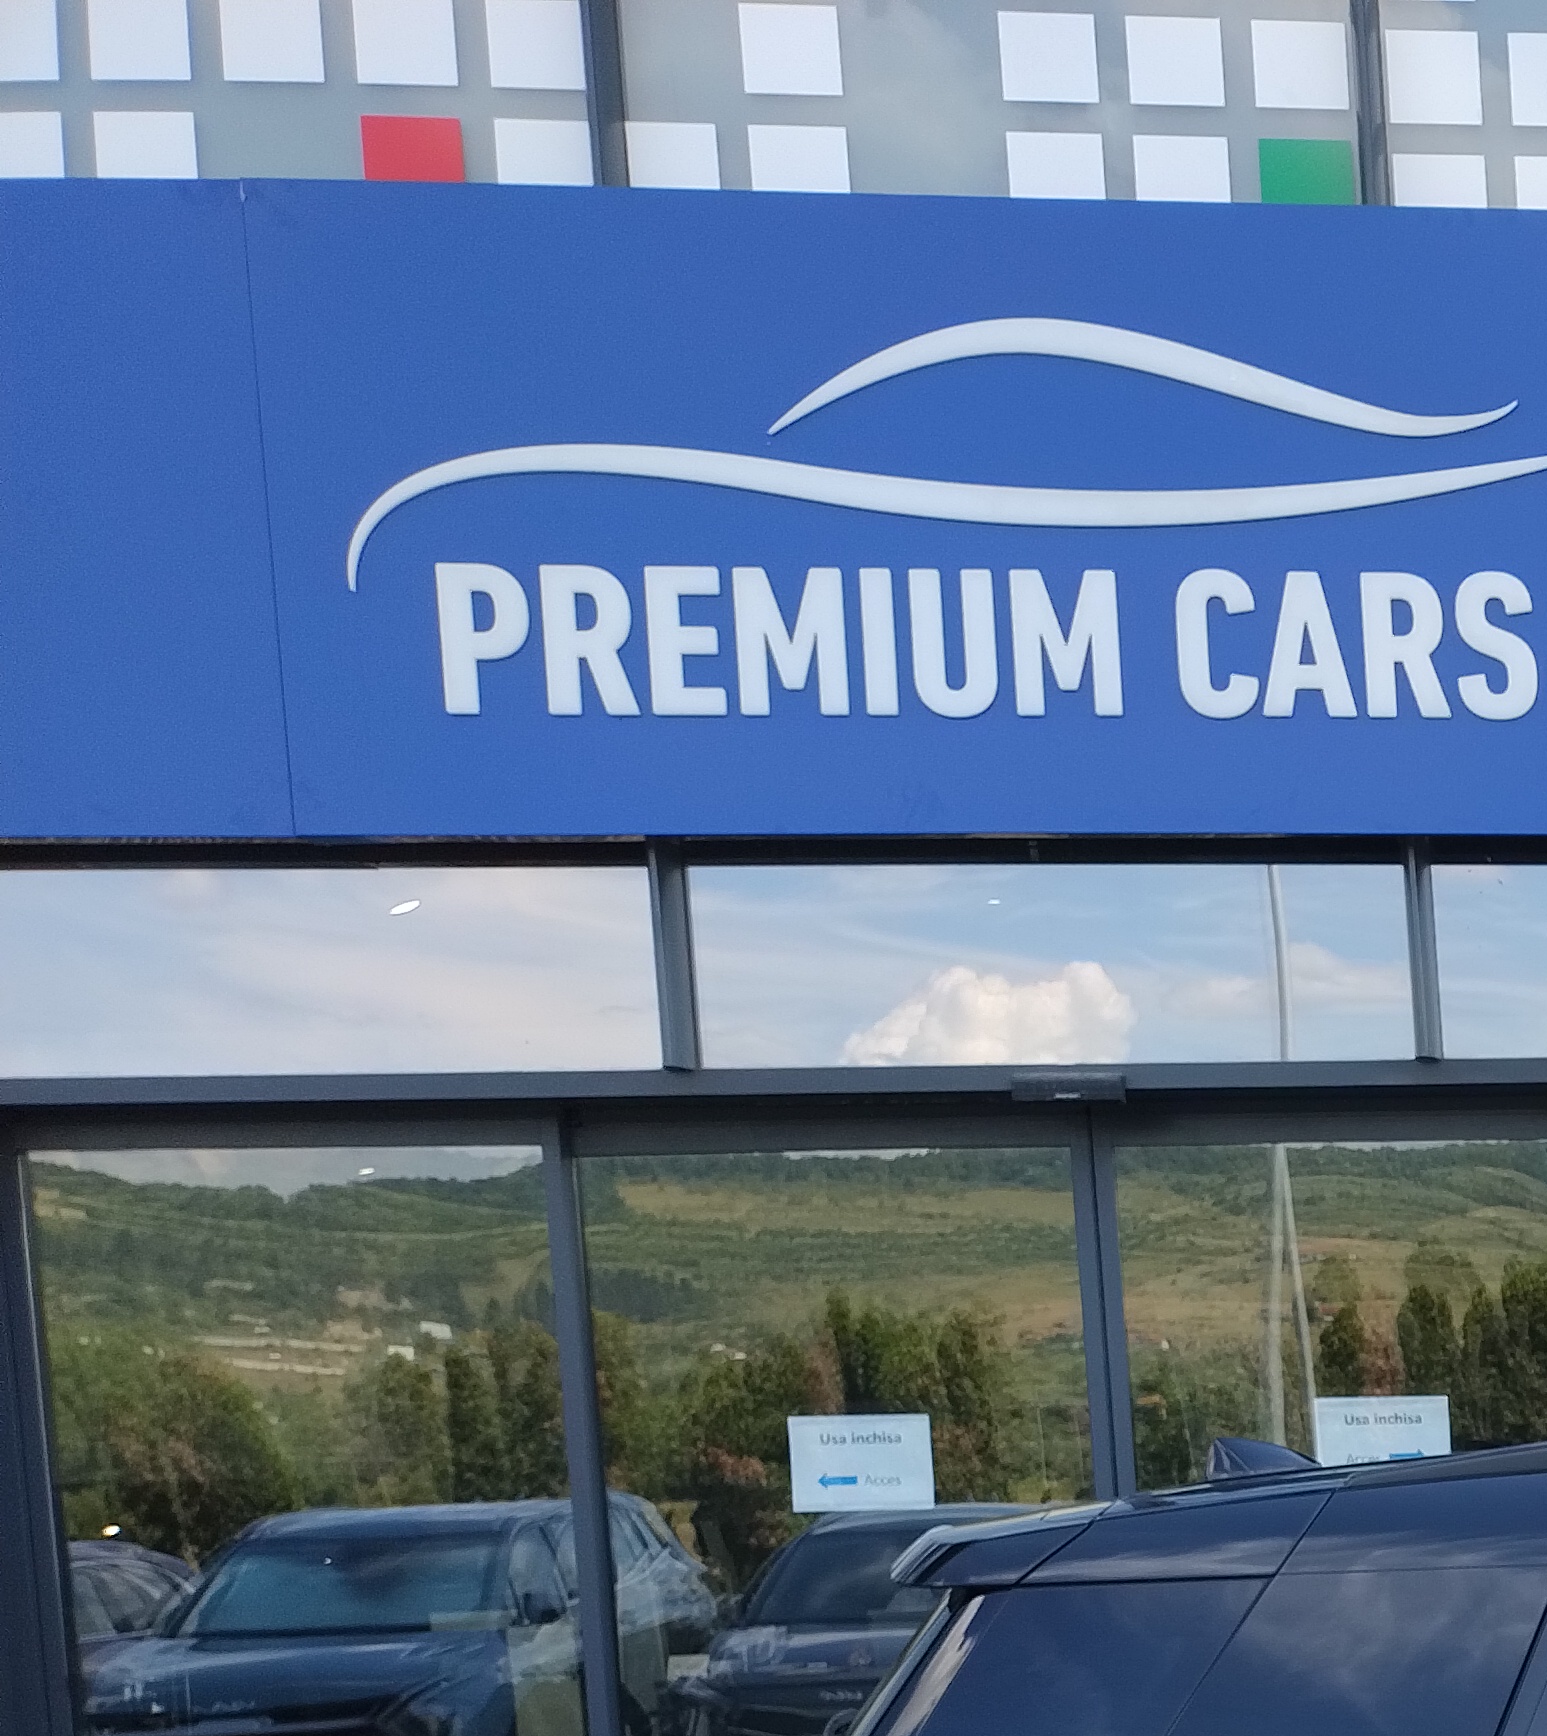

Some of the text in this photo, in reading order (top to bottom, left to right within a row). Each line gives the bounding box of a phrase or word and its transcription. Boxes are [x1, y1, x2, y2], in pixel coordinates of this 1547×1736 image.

[433, 561, 1539, 720] PREMIUM CARS
[1344, 1412, 1422, 1426] Usa inchisa
[820, 1431, 902, 1445] Usa inchisa
